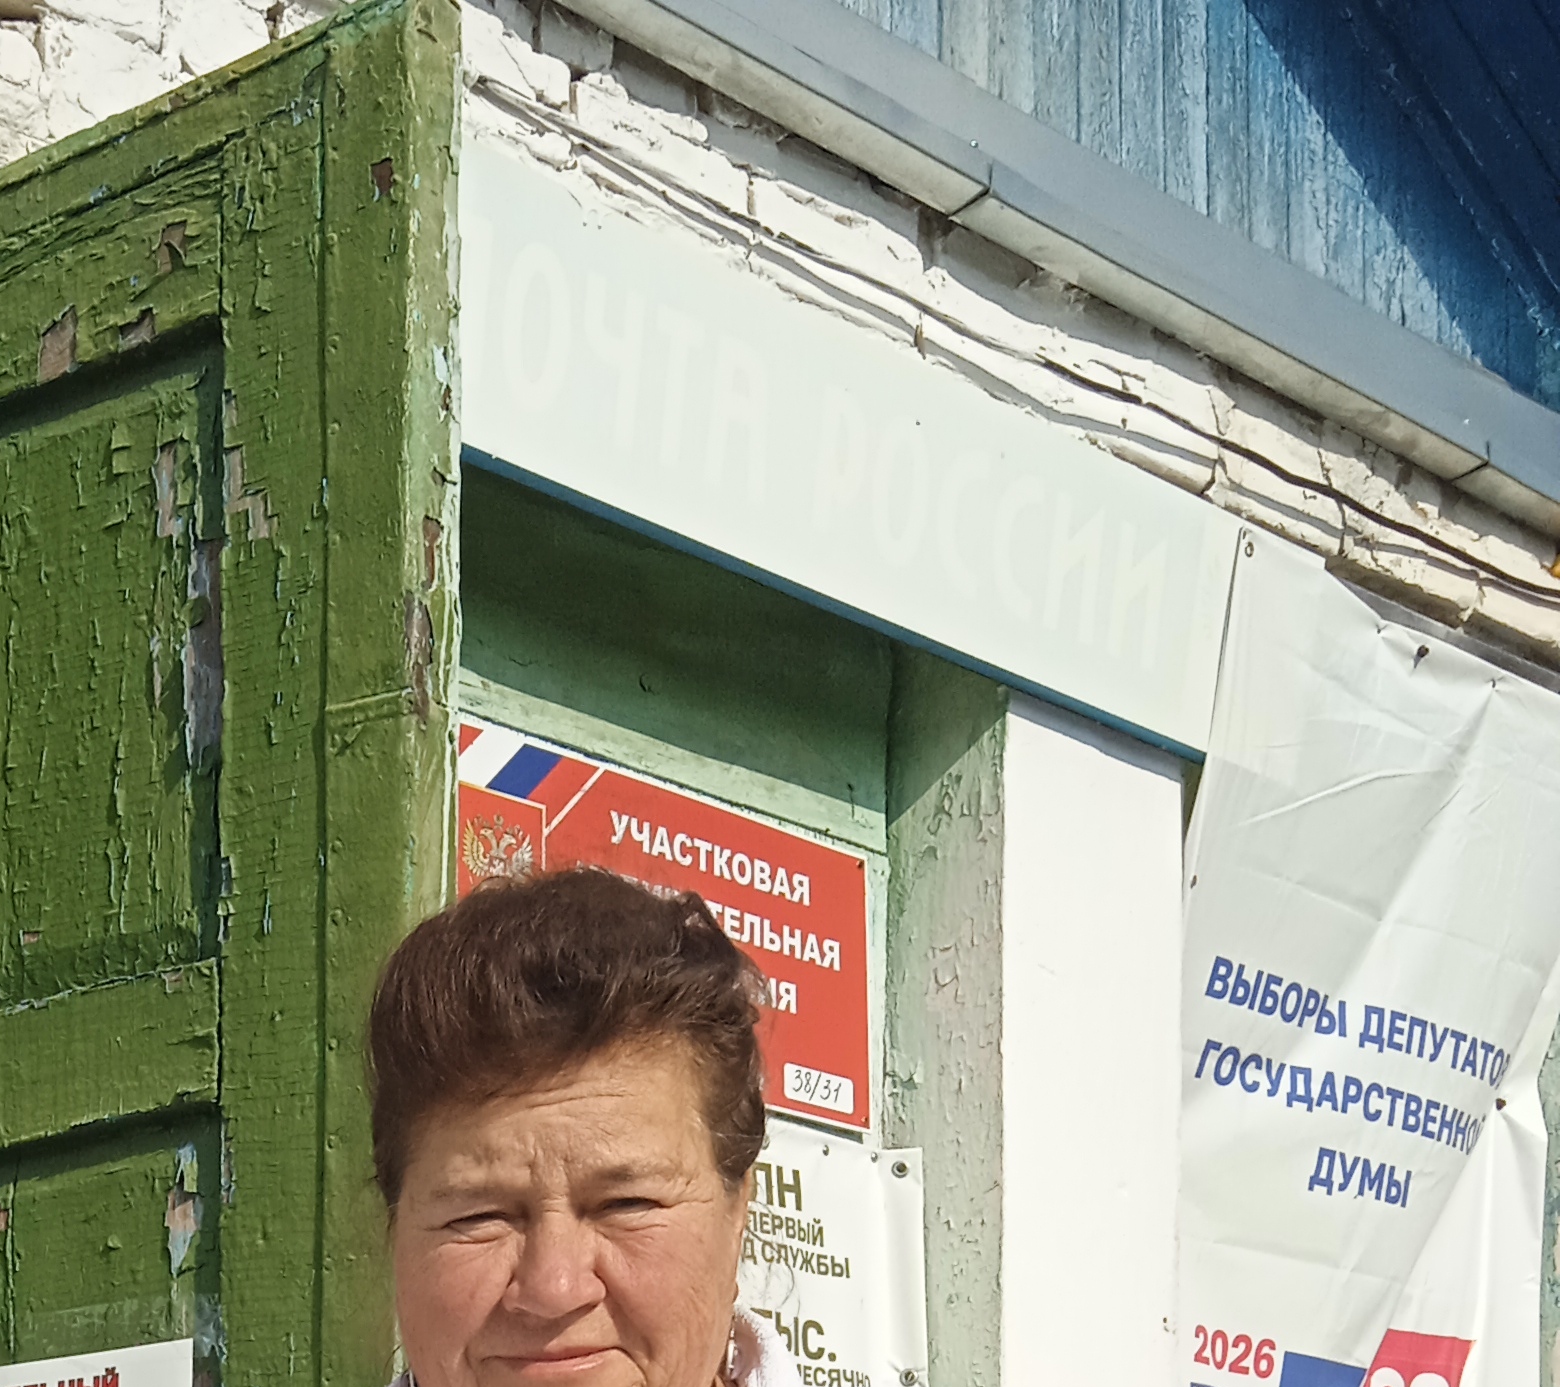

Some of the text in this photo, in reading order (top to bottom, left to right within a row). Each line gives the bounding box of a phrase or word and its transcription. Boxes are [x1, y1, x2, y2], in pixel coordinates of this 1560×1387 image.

[609, 810, 811, 906] УЧАСТКОВАЯ
[1204, 955, 1348, 1038] ВЫБОРЫ
[792, 1069, 842, 1103] 38/31
[751, 1162, 802, 1212] ЛН
[1307, 1147, 1413, 1209] ДУМЫ
[747, 1210, 825, 1247] ПЕРВЫЙ
[761, 1240, 851, 1279] СЛУЖБЫ
[1193, 1324, 1277, 1379] 2026
